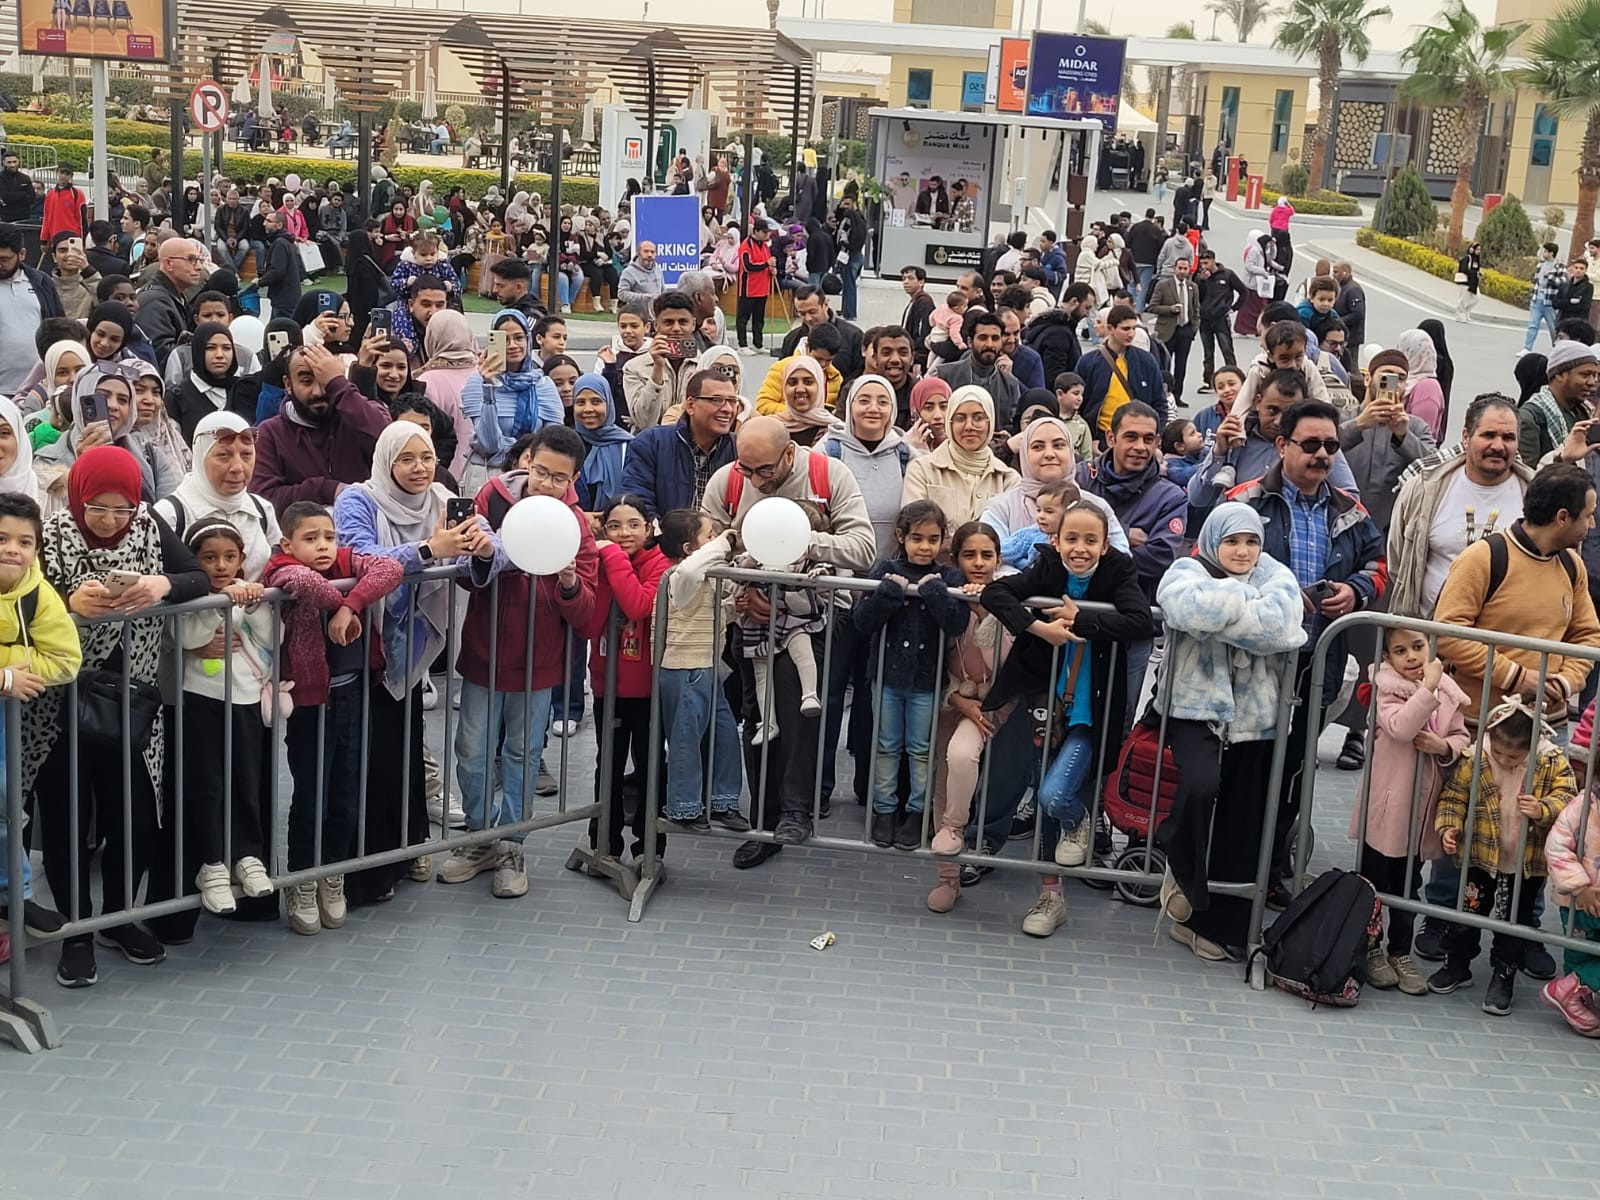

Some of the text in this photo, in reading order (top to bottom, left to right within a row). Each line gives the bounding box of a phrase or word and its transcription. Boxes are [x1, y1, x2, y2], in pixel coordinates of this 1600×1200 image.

[1058, 58, 1098, 71] MIDAR
[202, 90, 221, 125] P
[657, 243, 697, 256] RKING
[668, 261, 699, 272] ساحات
